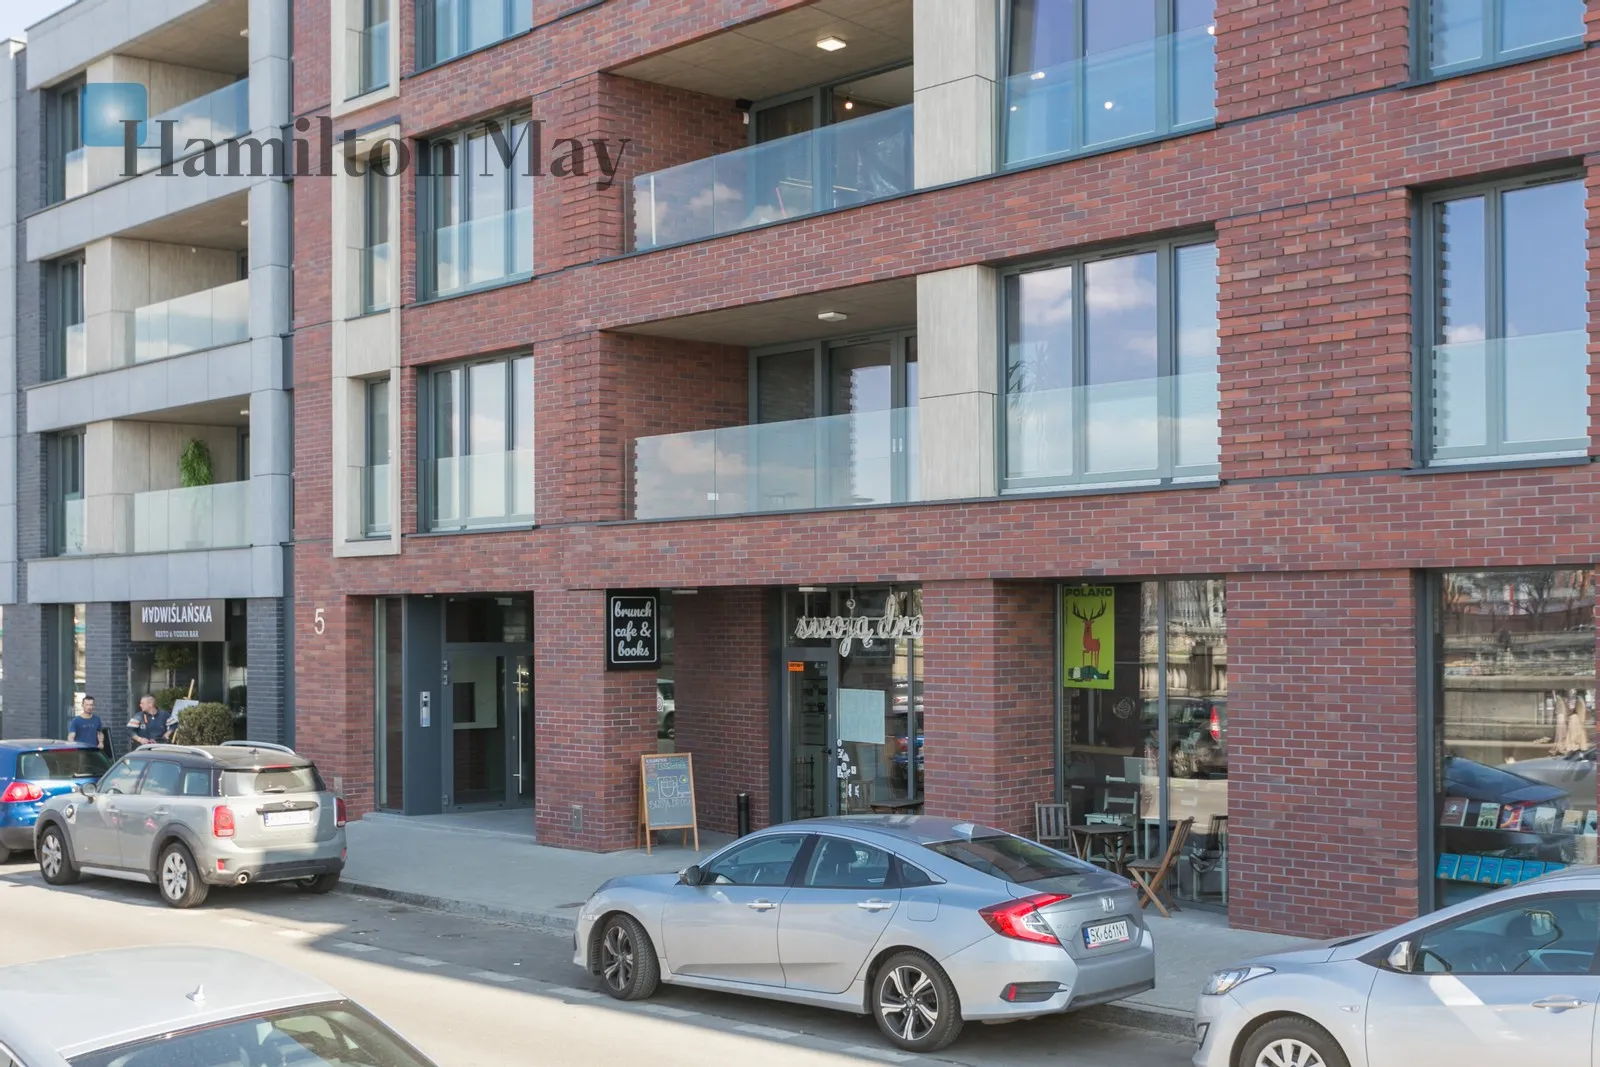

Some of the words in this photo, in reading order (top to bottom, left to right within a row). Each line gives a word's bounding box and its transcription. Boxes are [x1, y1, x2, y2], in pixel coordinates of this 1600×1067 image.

[1065, 587, 1113, 597] POLAND
[614, 600, 652, 617] brunch
[314, 608, 325, 635] 5
[614, 620, 638, 642] cafe
[640, 621, 652, 637] &
[617, 640, 650, 656] books
[1090, 928, 1101, 942] SK
[1103, 923, 1126, 940] 661NY
